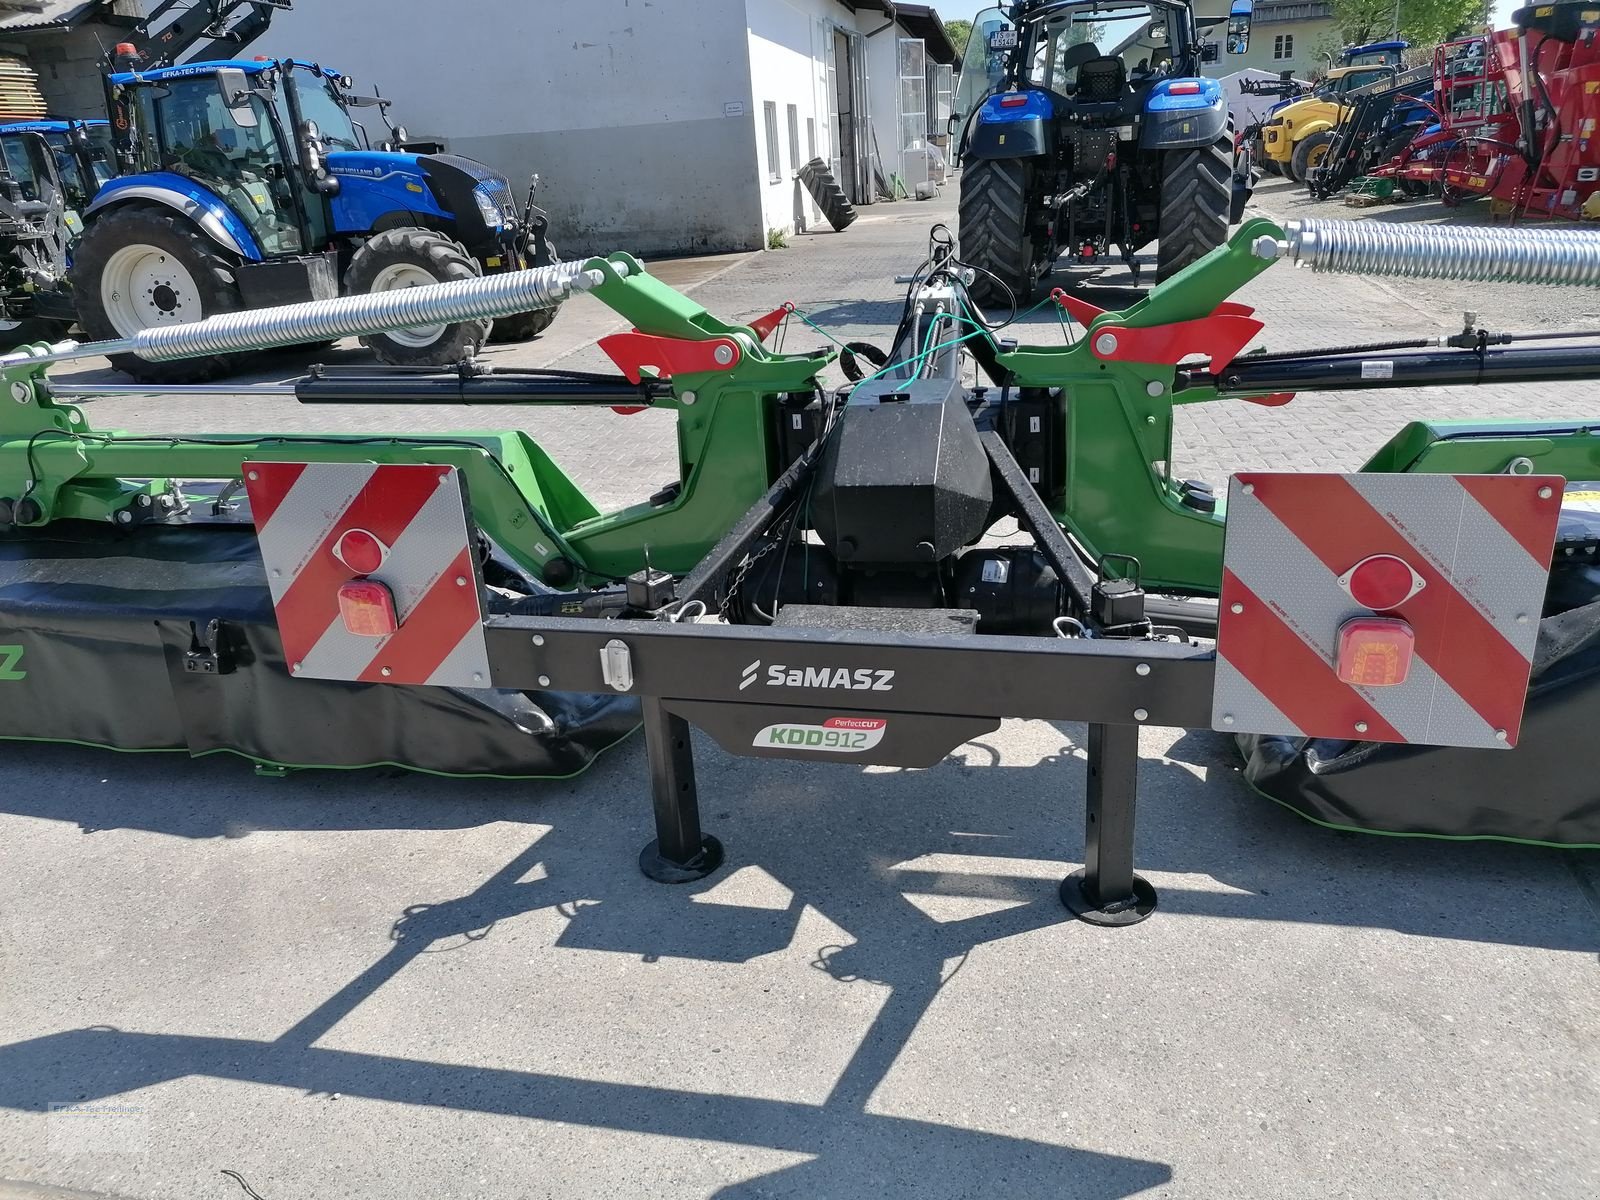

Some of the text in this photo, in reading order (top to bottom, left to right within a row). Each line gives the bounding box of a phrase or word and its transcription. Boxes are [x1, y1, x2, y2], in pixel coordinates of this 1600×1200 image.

[345, 168, 374, 176] HOLLAND
[766, 664, 895, 691] SaMASZ
[834, 719, 880, 728] PerfectCUT
[769, 727, 868, 749] KDD912
